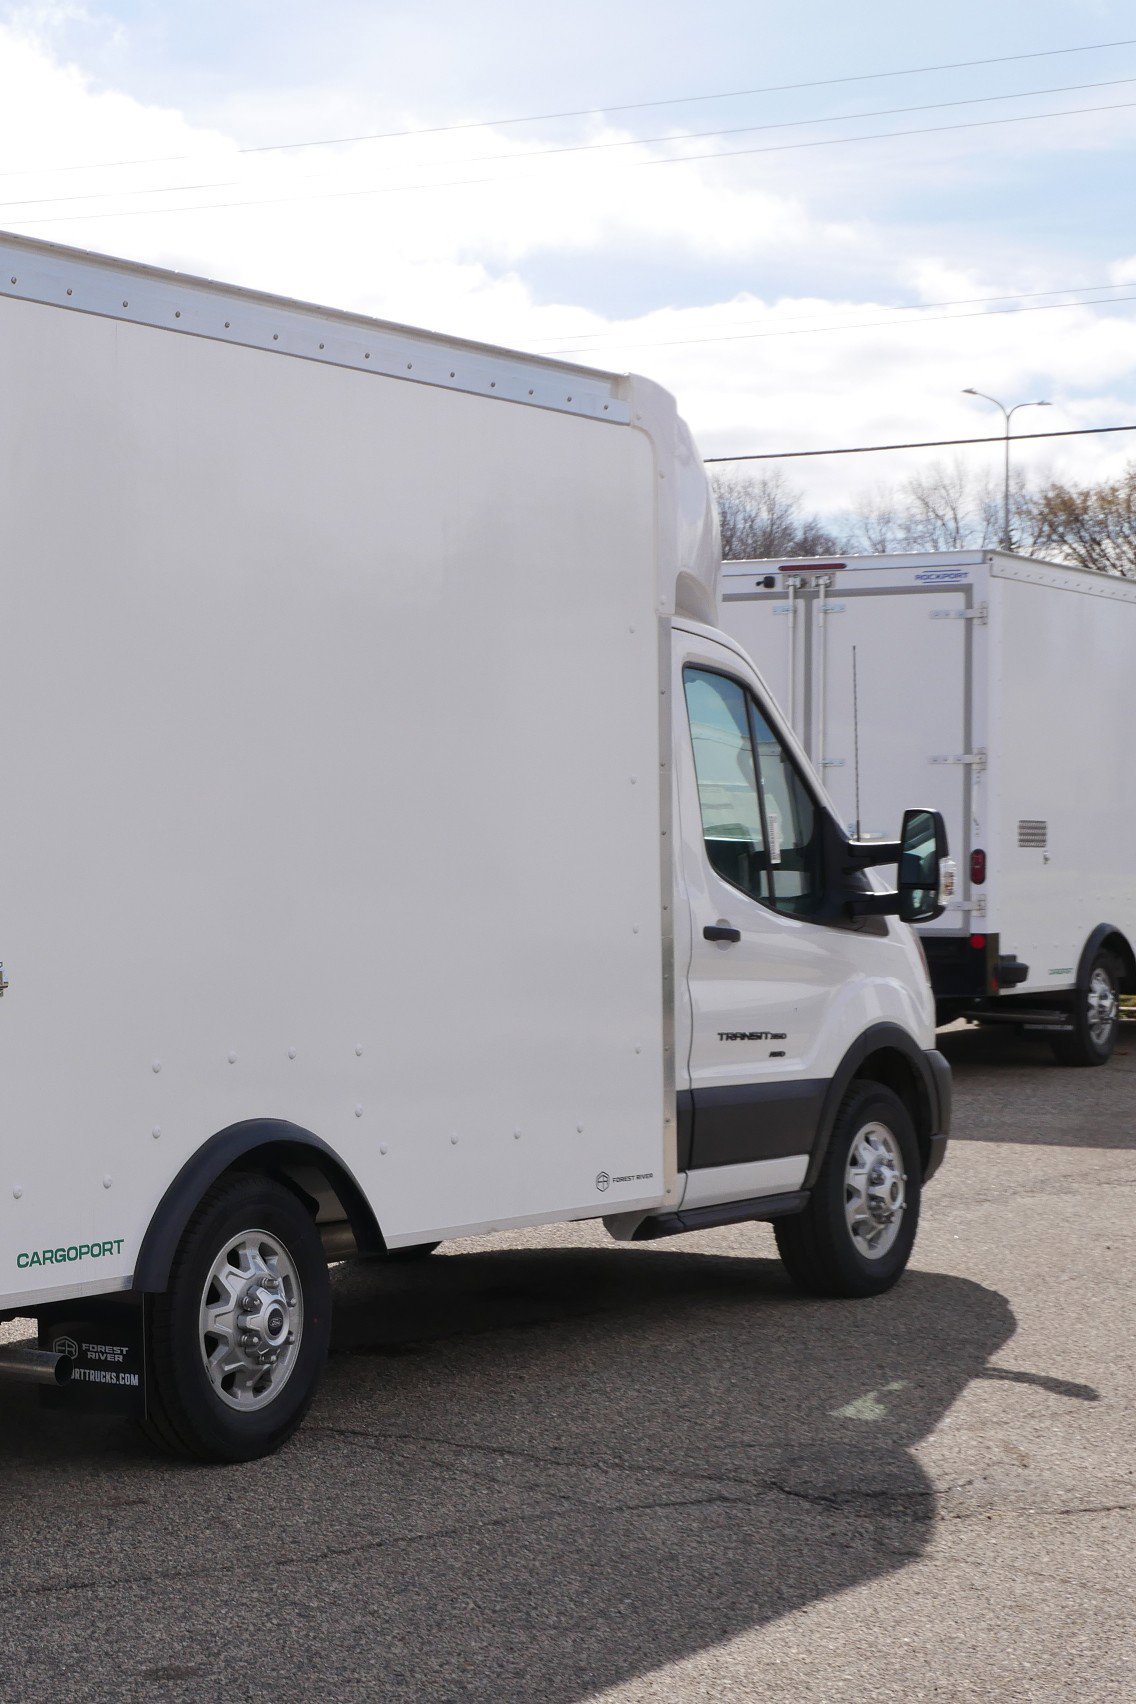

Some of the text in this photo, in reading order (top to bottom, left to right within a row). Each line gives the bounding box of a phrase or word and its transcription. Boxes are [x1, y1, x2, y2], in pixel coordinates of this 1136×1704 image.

[717, 1031, 771, 1041] TRANSIT
[612, 1175, 635, 1183] FOREST
[16, 1238, 125, 1269] CARGOPORT
[82, 1343, 129, 1355] FOREST
[87, 1352, 123, 1362] RIVER
